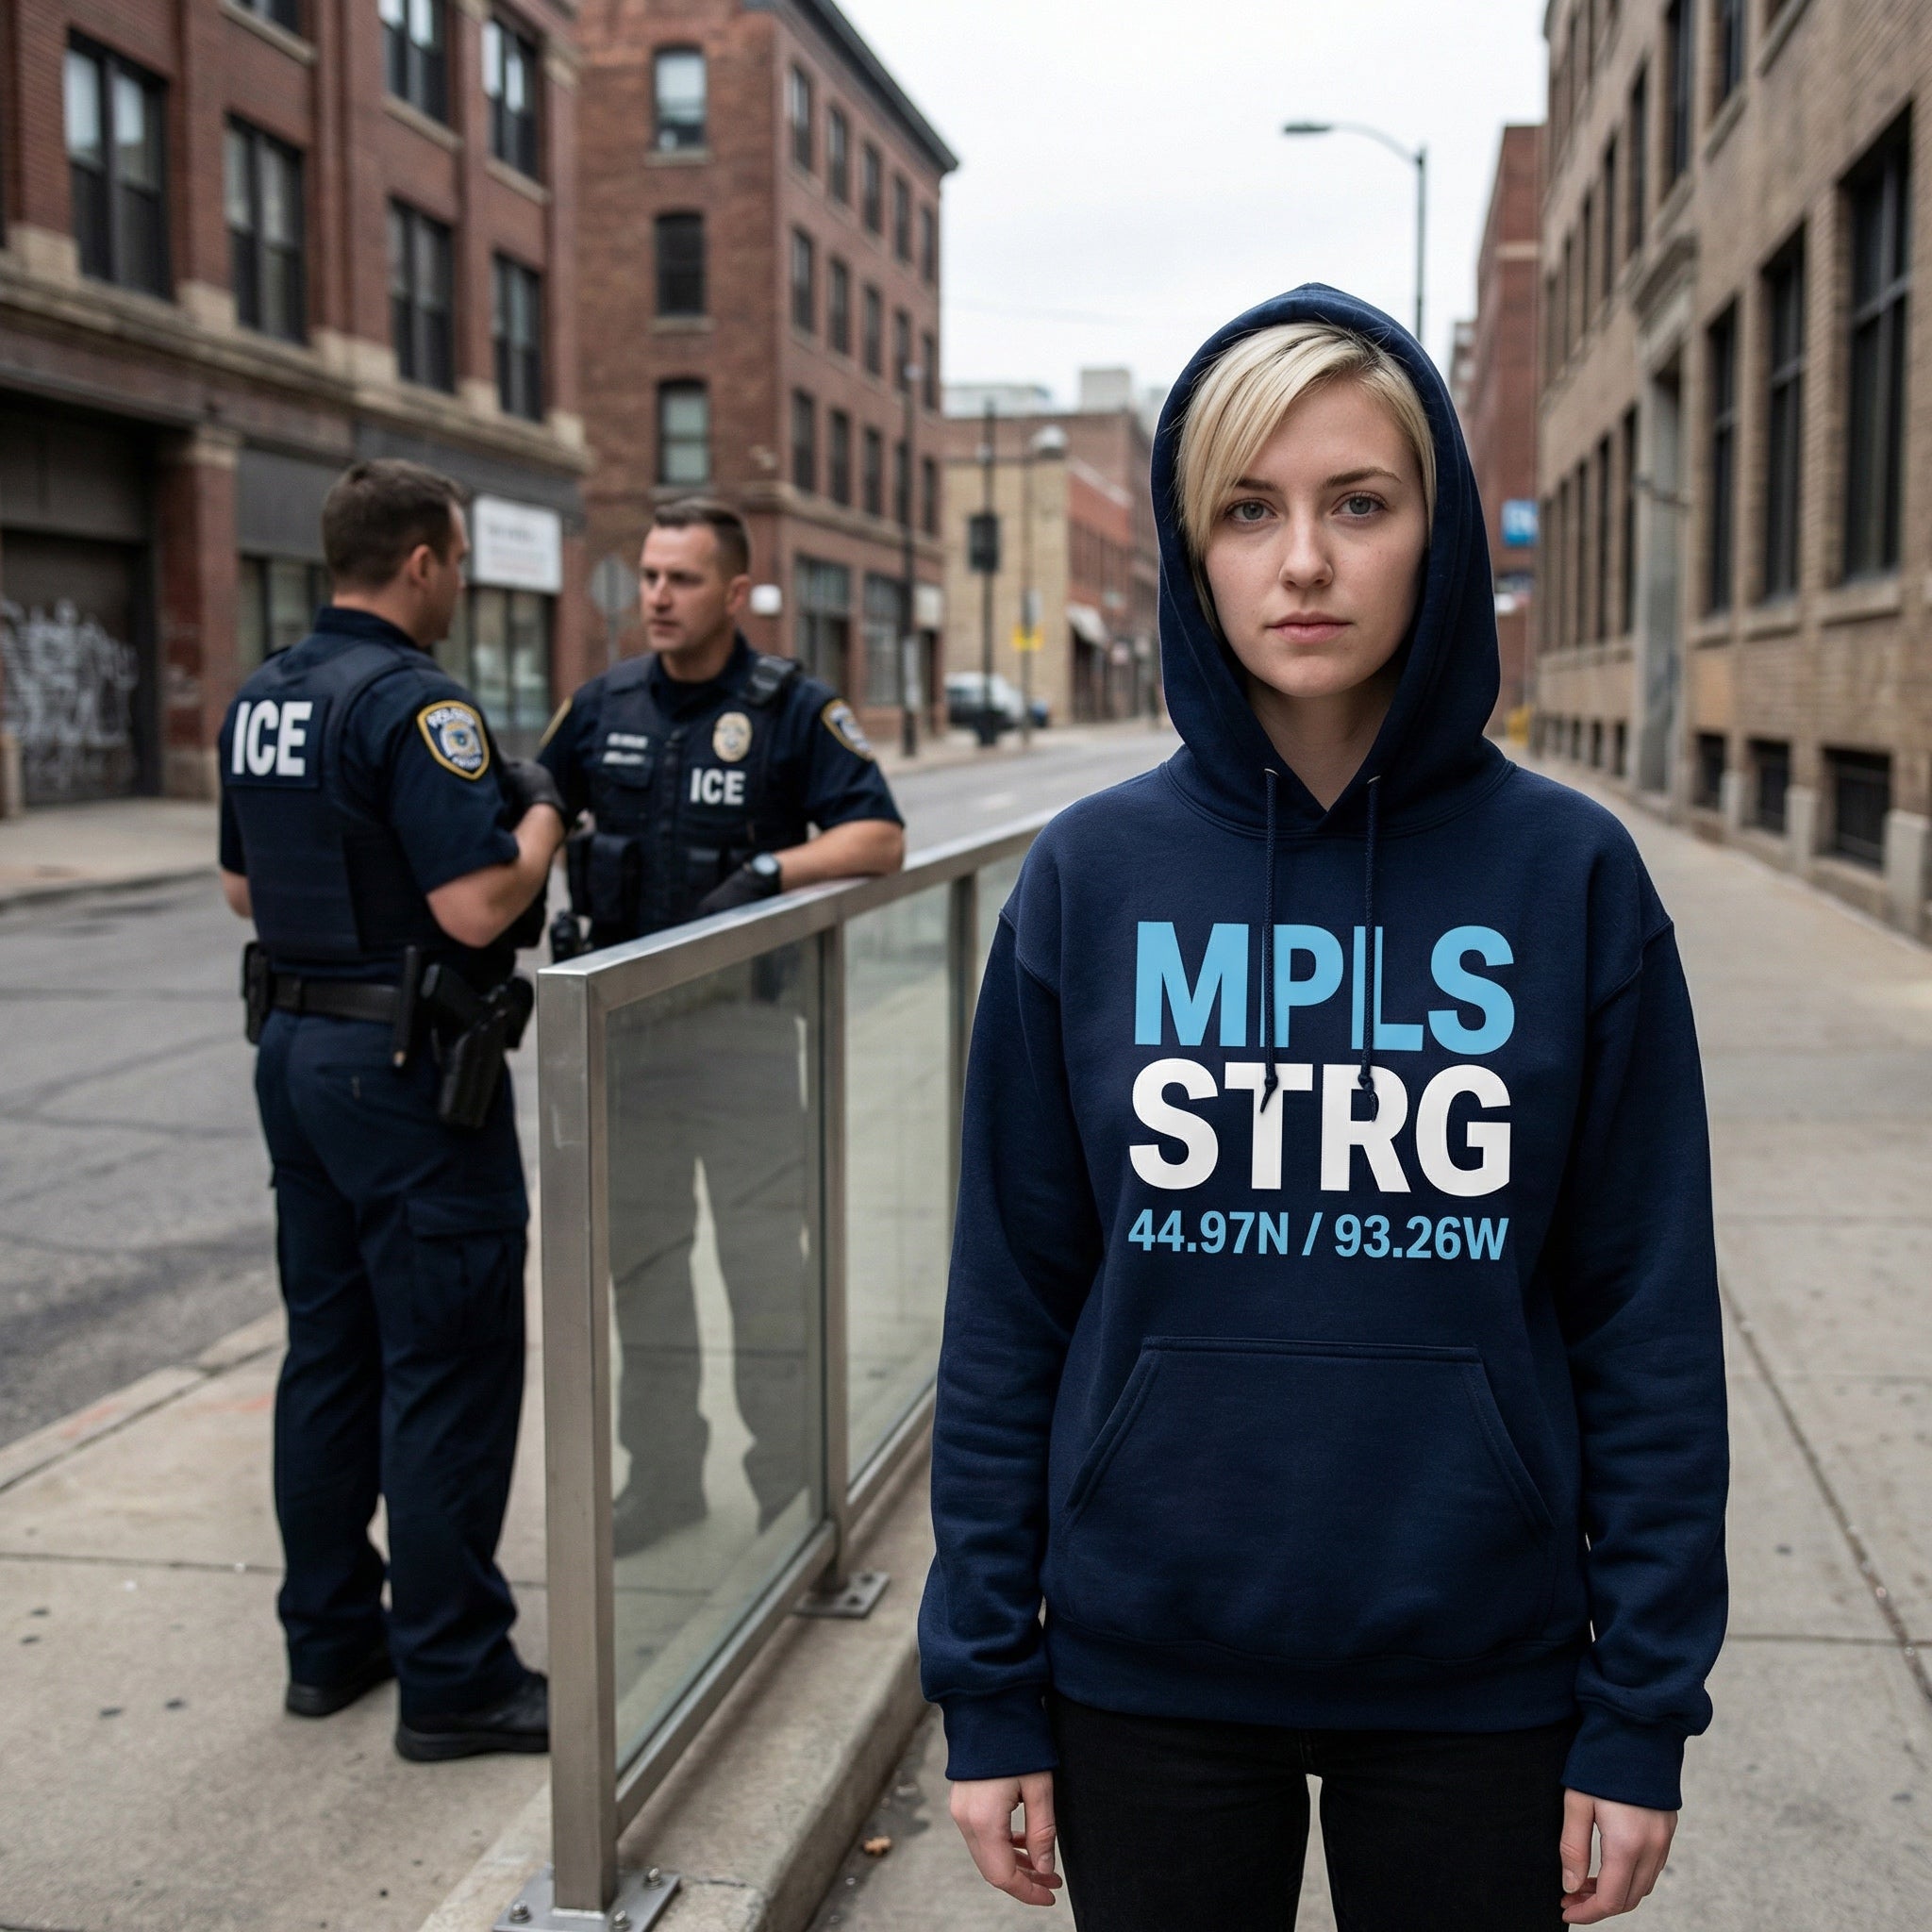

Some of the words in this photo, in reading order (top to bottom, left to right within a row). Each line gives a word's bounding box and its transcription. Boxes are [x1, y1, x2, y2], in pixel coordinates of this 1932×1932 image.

[232, 700, 313, 775] ICE
[690, 768, 745, 804] ICE
[1135, 922, 1514, 1055] MPLS
[1129, 1058, 1510, 1196] STRG
[1128, 1209, 1289, 1255] 44.97N
[1302, 1212, 1323, 1256] /
[1335, 1214, 1508, 1259] 93.26W
